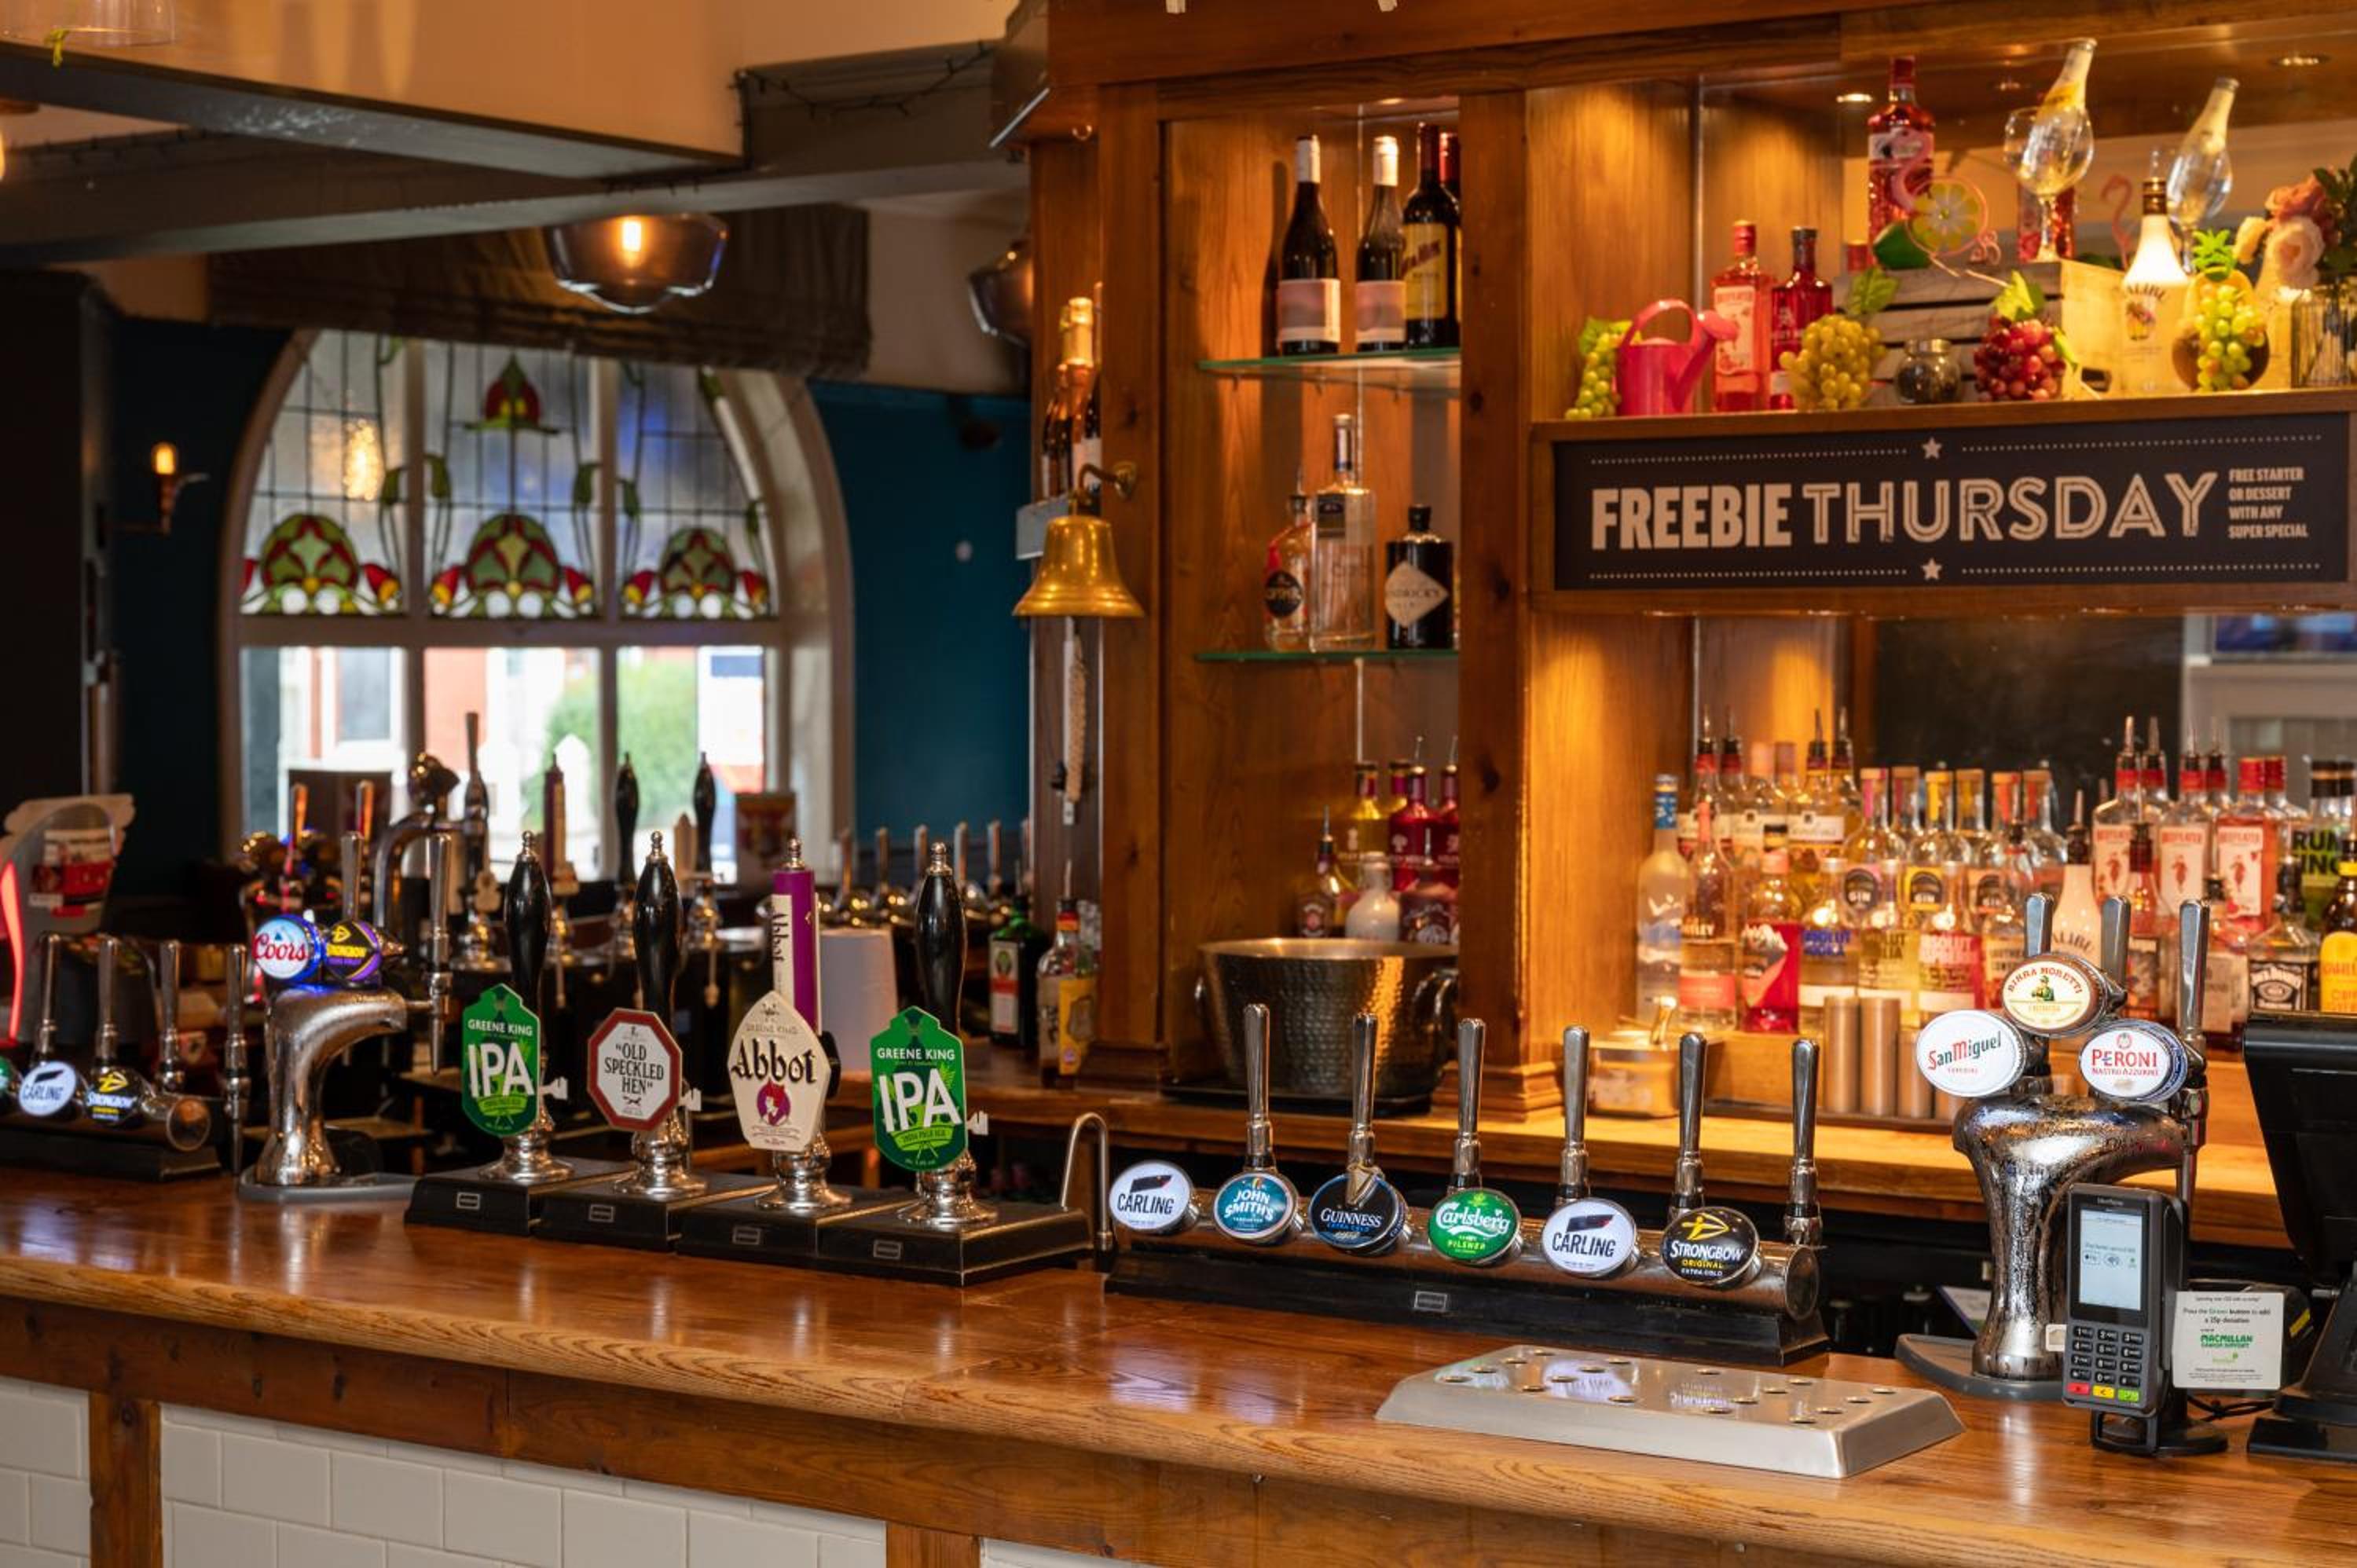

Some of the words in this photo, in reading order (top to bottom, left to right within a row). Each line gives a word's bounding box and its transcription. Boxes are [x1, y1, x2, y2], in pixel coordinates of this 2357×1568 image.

[2229, 467, 2255, 482] FREE
[2256, 466, 2304, 482] STARTER
[2229, 487, 2245, 500] OR
[2245, 486, 2292, 500] DESSERT
[1592, 483, 1792, 549] FREEBIE
[1802, 472, 2219, 544] THURSDAY
[2229, 505, 2260, 520] WITH
[2260, 504, 2283, 519] ANY
[2229, 524, 2263, 539] SUPER
[2264, 522, 2308, 538] SPECIAL
[251, 932, 309, 961] Coors
[2008, 969, 2037, 992] BIRRA
[2040, 967, 2083, 994] MORETTI
[468, 1019, 507, 1034] GREENE
[508, 1023, 533, 1036] KING
[731, 1038, 817, 1084] Abbot
[877, 1046, 922, 1060] GREENE
[925, 1049, 956, 1061] KING
[2092, 1049, 2157, 1068] PERONI
[468, 1042, 535, 1098] IPA
[604, 1057, 665, 1081] SPECKLED
[878, 1068, 963, 1134] IPA
[1117, 1193, 1175, 1214] CARLING
[1233, 1189, 1270, 1204] JOHN
[1321, 1207, 1383, 1228] GUINNESS
[1436, 1201, 1510, 1237] Carlsberg
[1552, 1232, 1617, 1258] CARLING
[1670, 1240, 1743, 1261] STRONGBOW
[1682, 1259, 1723, 1269] ORIGINAL
